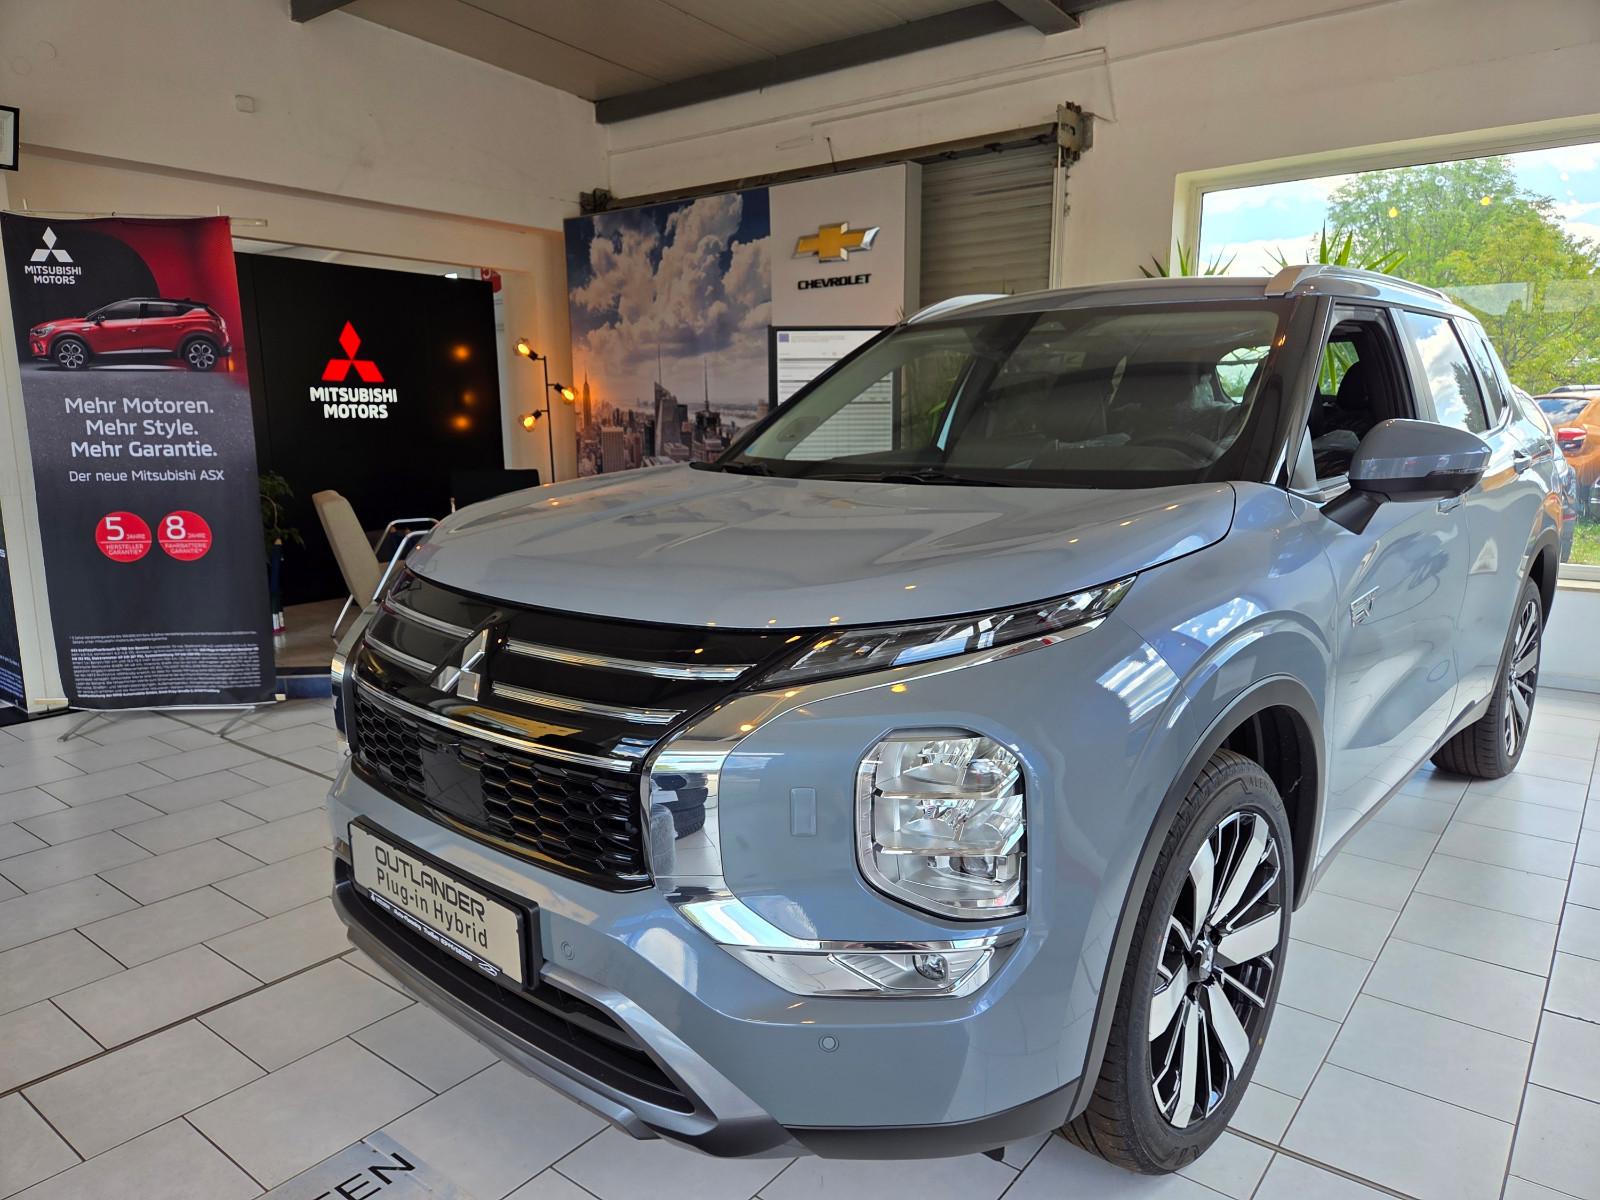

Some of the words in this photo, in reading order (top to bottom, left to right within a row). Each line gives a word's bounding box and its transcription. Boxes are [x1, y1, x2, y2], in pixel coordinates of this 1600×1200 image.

[24, 265, 82, 276] MITSUBISHI
[33, 275, 76, 285] MOTORS
[797, 273, 872, 290] CHEVROLET
[309, 386, 398, 403] MITSUBISHI
[64, 397, 117, 414] Mehr
[123, 397, 214, 414] Motoren.
[323, 403, 389, 419] MOTORS
[86, 419, 137, 436] Mehr
[143, 418, 199, 439] Style.
[71, 441, 123, 458] Mehr
[128, 440, 217, 457] Garantie.
[69, 471, 91, 482] Der
[96, 473, 127, 482] neue
[131, 470, 196, 482] Mitsubishi
[200, 470, 225, 481] ASX
[105, 516, 125, 541] 5
[166, 515, 186, 540] 8
[374, 845, 485, 922] OUTLANDER
[376, 867, 429, 914] Plug-in
[433, 899, 489, 949] Hybrid
[314, 1152, 416, 1200] EN
